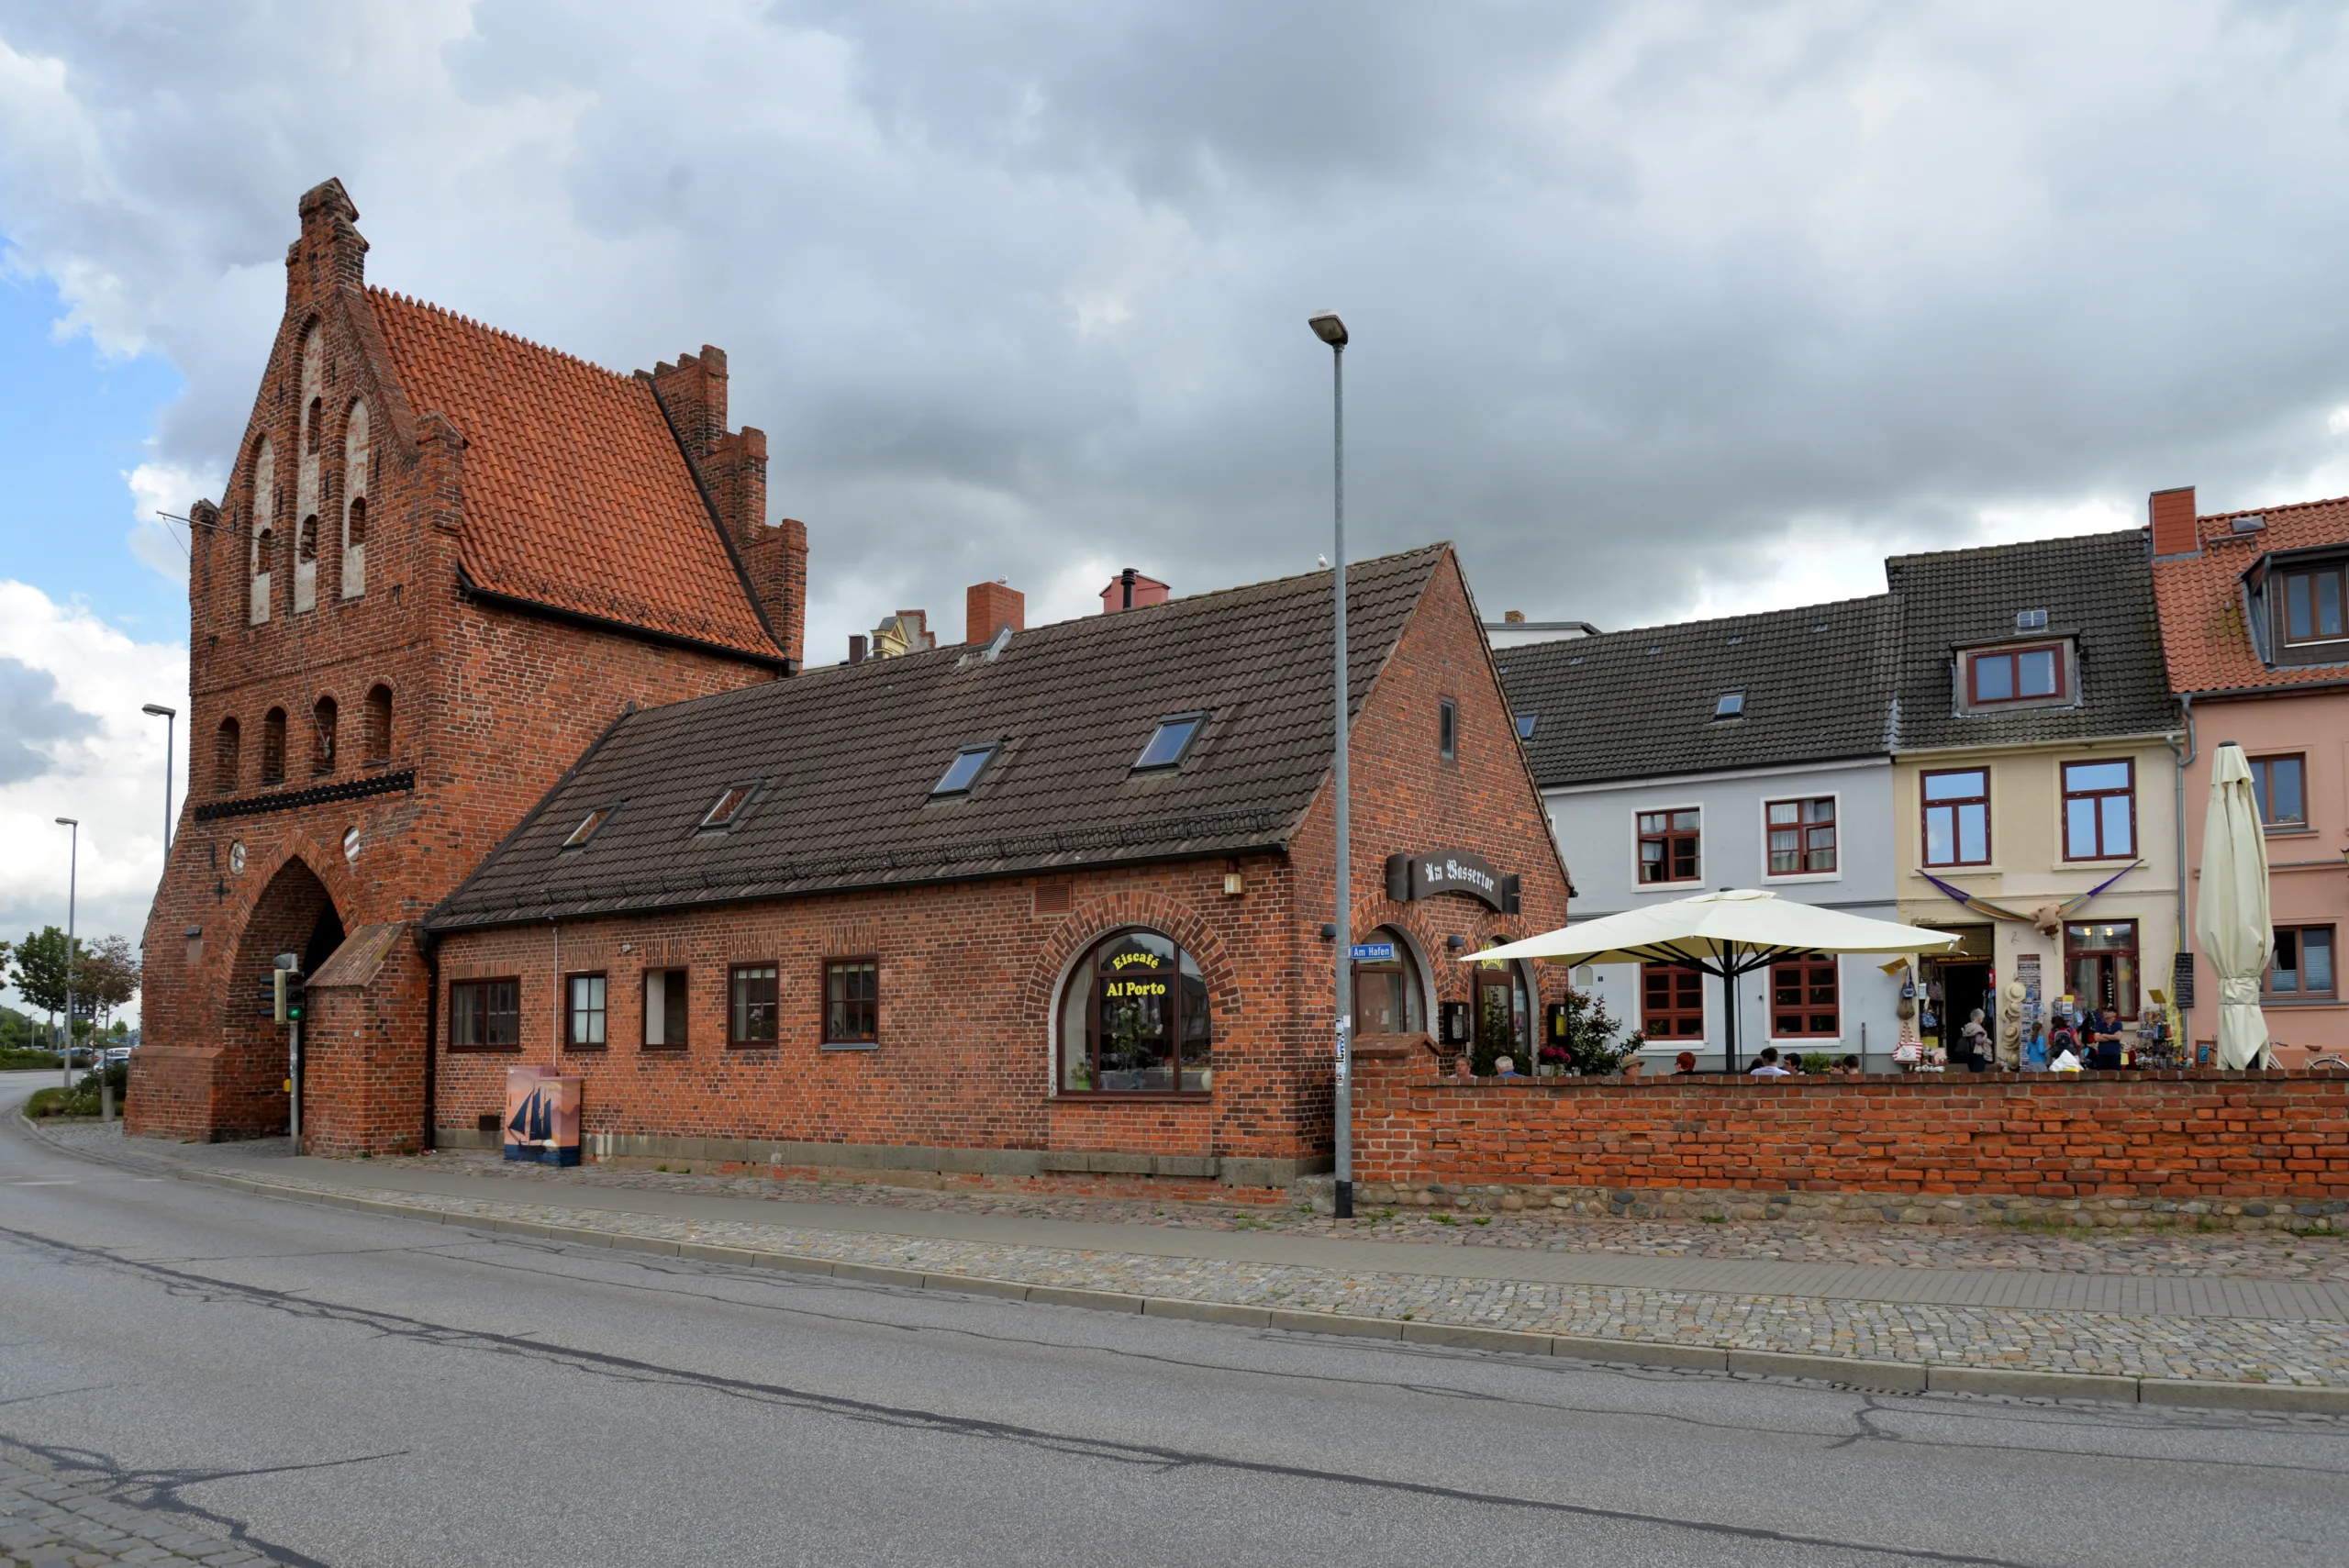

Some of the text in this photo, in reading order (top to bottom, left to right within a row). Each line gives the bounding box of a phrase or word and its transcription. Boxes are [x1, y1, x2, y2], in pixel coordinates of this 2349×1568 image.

[1425, 859, 1495, 893] Am Wassertor
[1353, 946, 1390, 957] Am Hafen
[1112, 952, 1160, 971] Eiscafé
[1107, 982, 1166, 996] Al Porto
